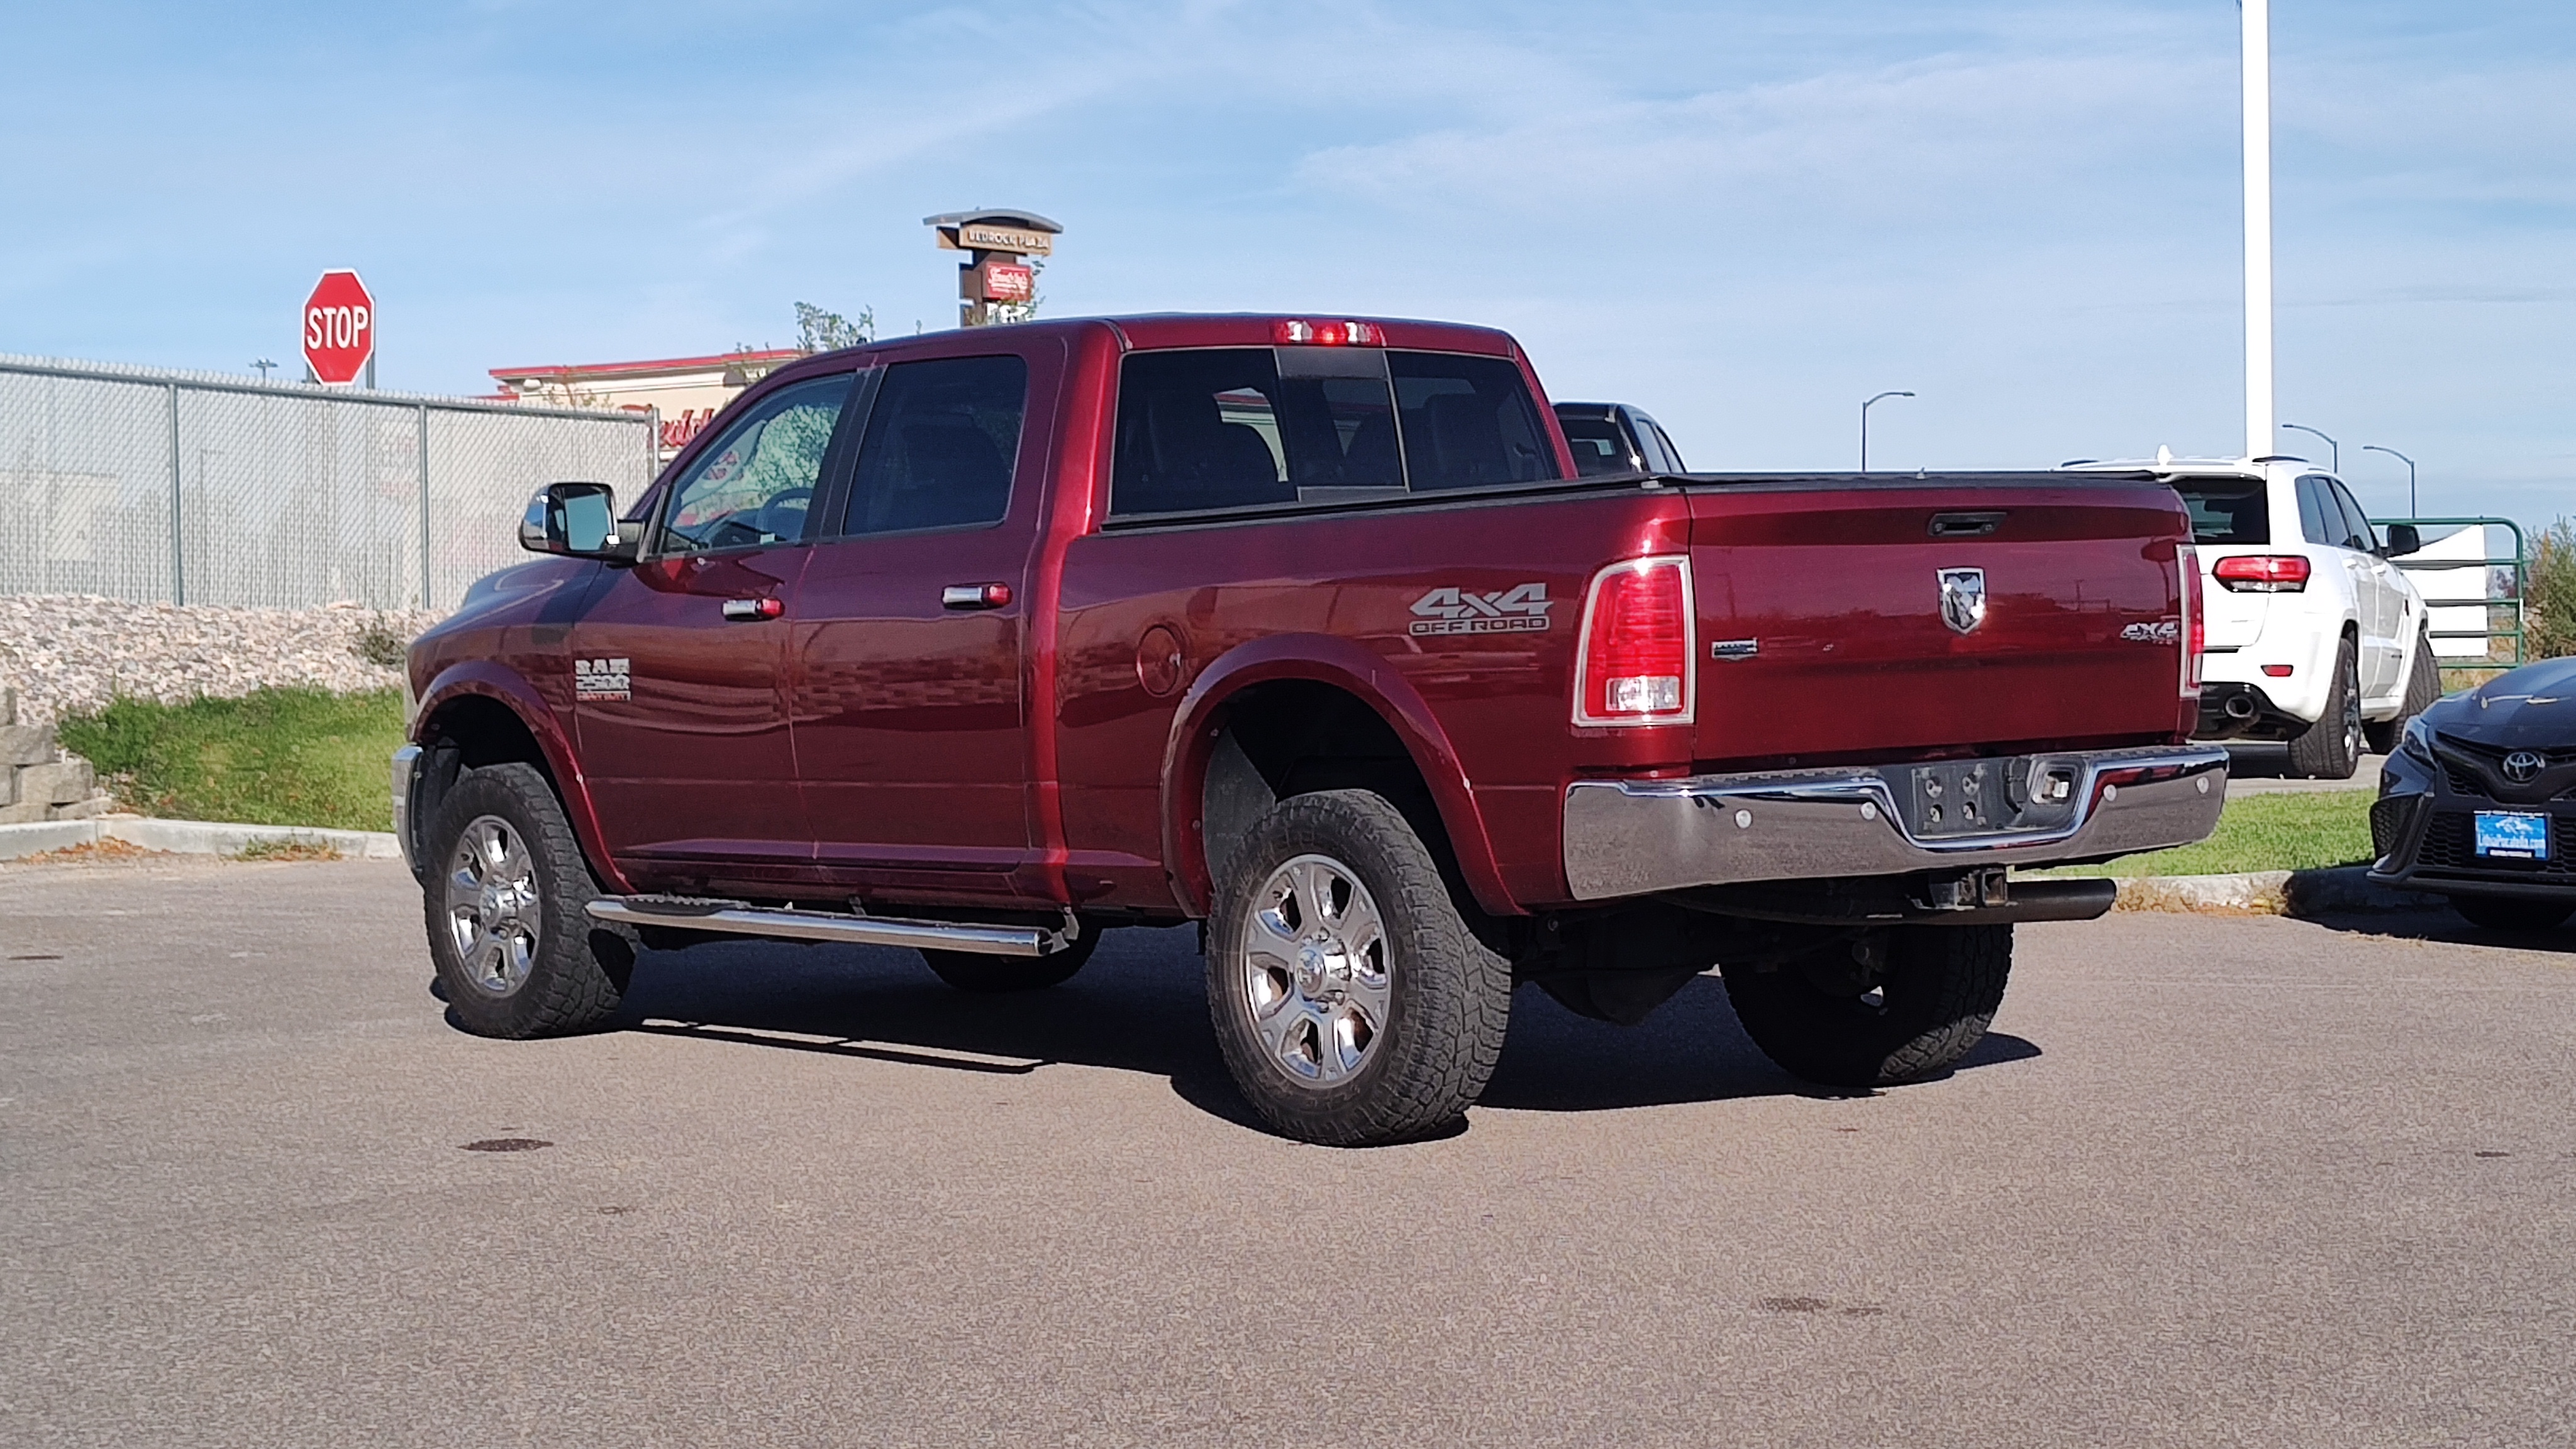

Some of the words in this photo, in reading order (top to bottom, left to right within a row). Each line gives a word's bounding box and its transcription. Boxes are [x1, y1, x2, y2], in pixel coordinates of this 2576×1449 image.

[969, 230, 1016, 246] BEDROCK
[1018, 235, 1049, 248] PLAZA
[307, 305, 369, 350] STOP
[1411, 621, 1466, 634] OFF
[1470, 618, 1546, 631] ROAD
